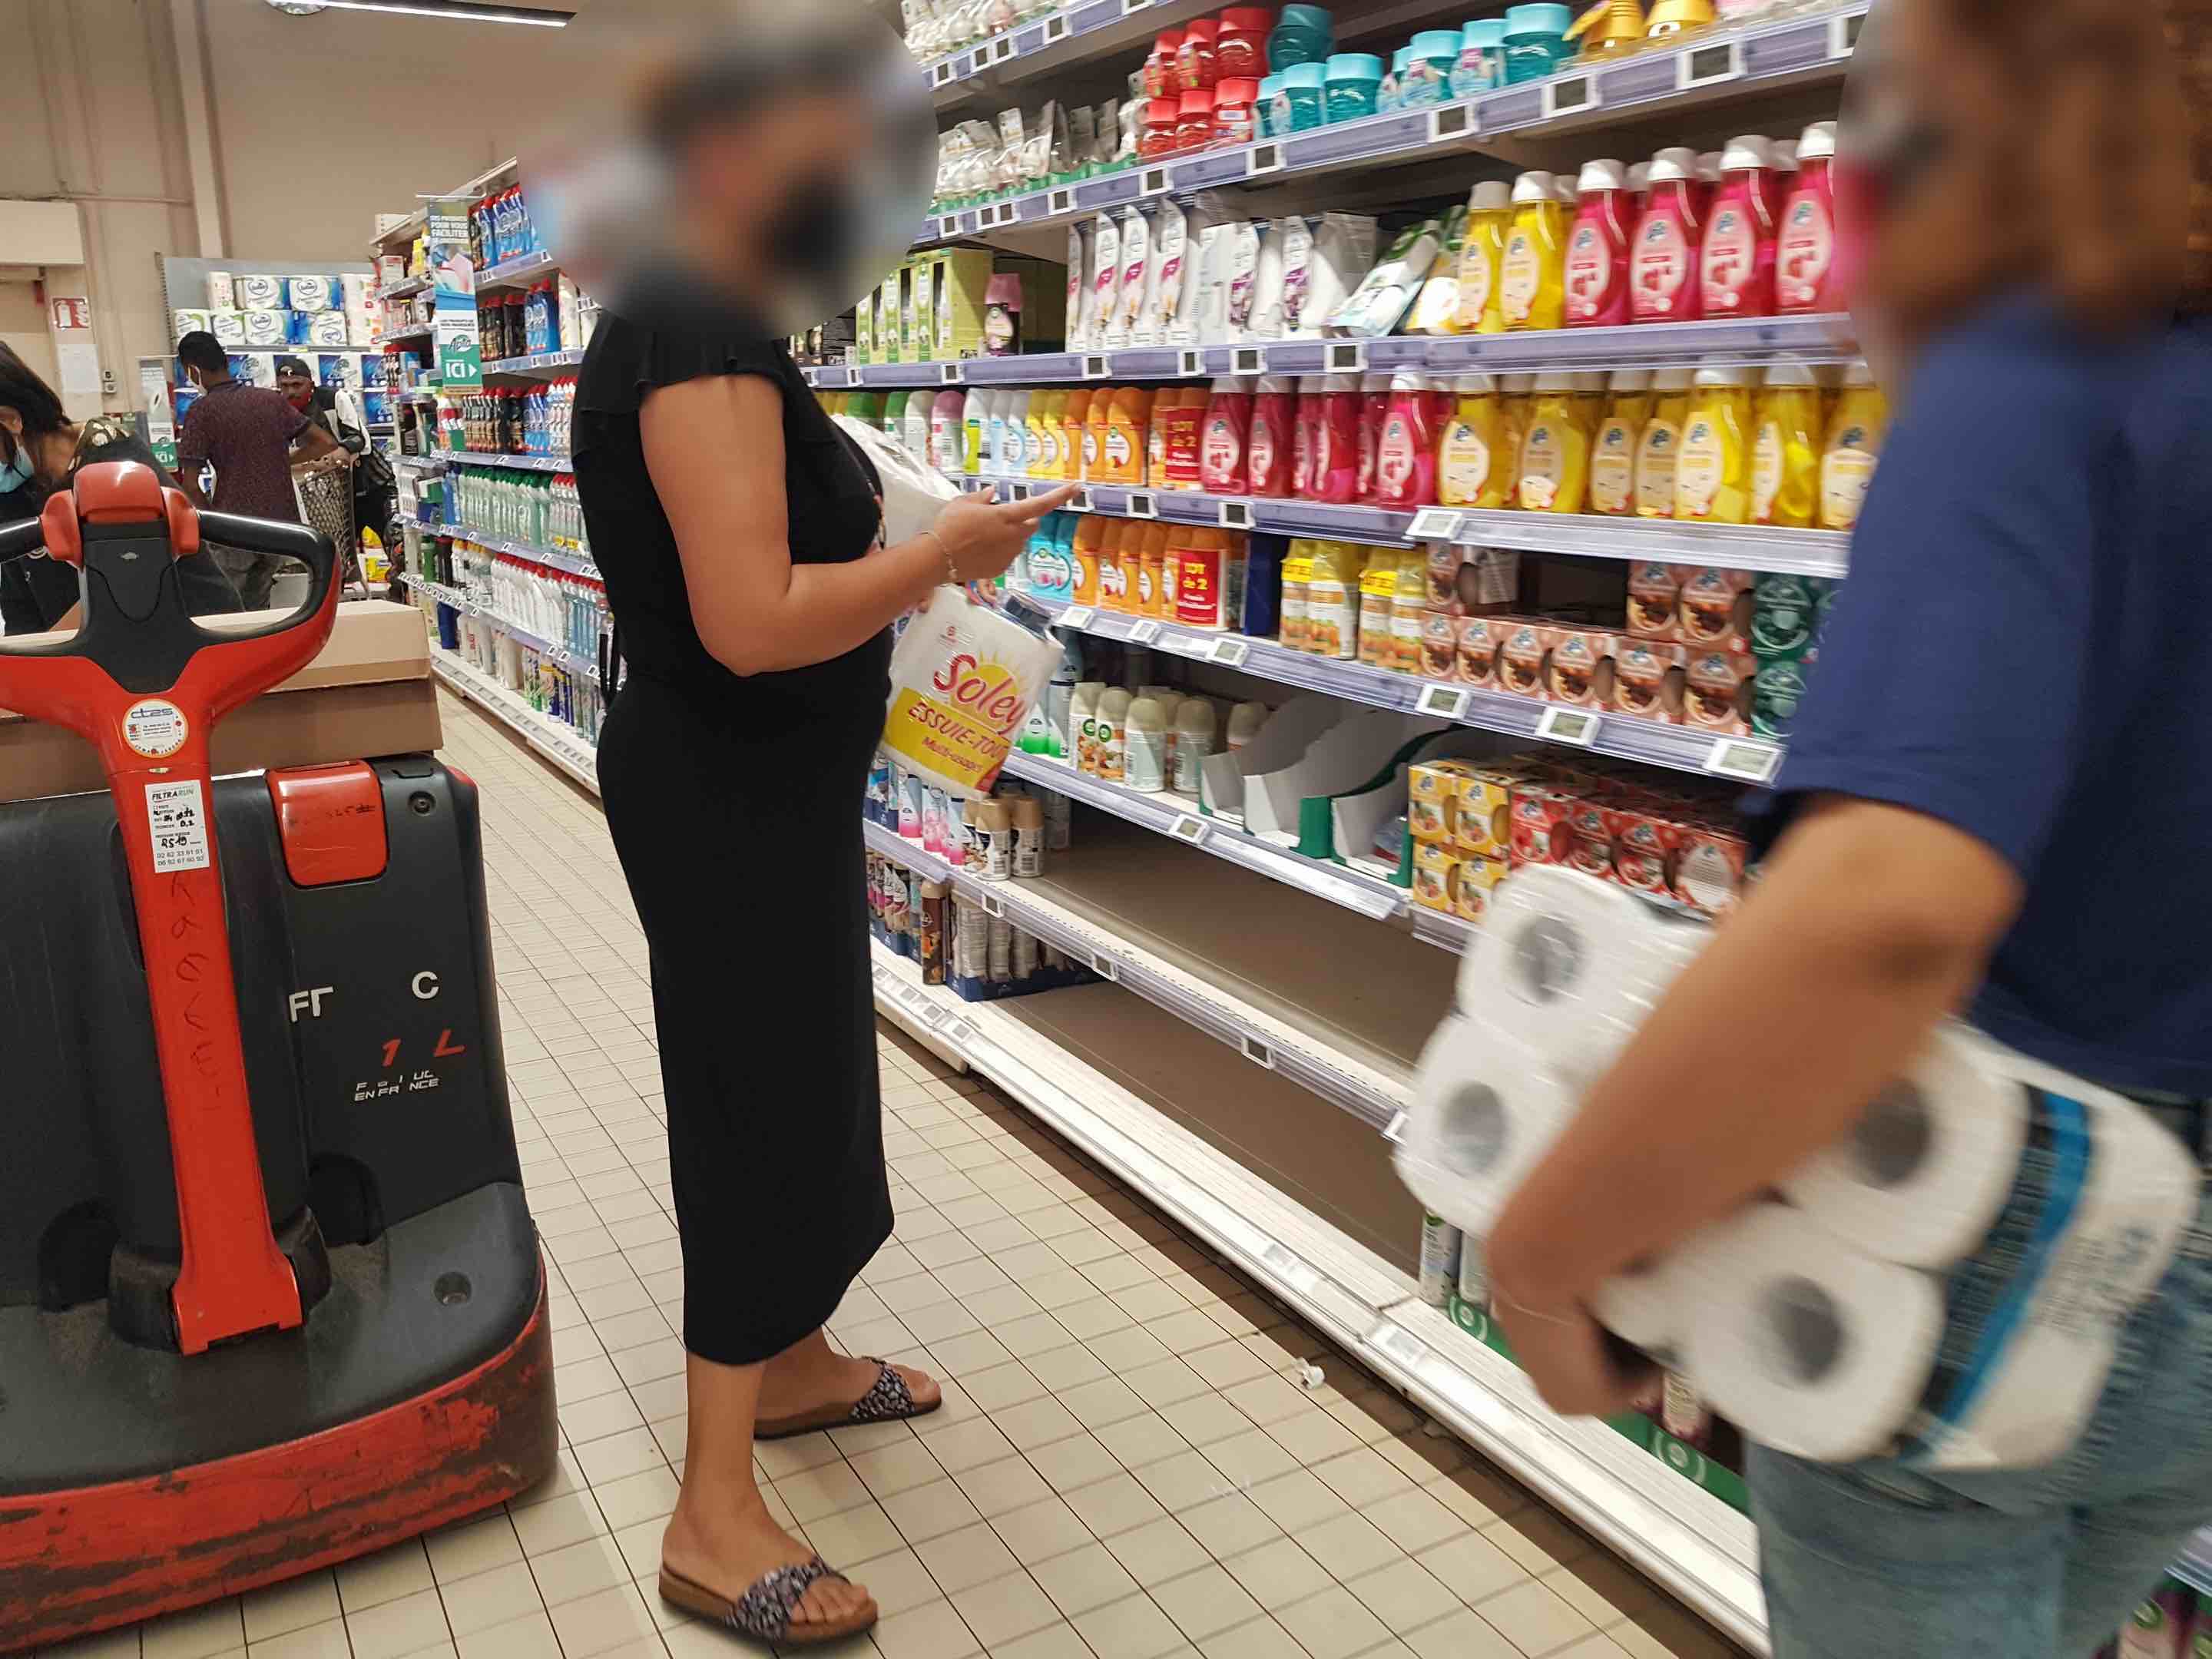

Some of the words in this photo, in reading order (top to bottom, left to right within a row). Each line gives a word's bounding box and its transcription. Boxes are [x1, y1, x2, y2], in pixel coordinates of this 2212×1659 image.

[445, 362, 465, 378] ICI
[1197, 578, 1209, 590] 2
[934, 654, 1027, 735] Soley
[355, 1090, 376, 1101] EN
[378, 1078, 439, 1097] FRNCE
